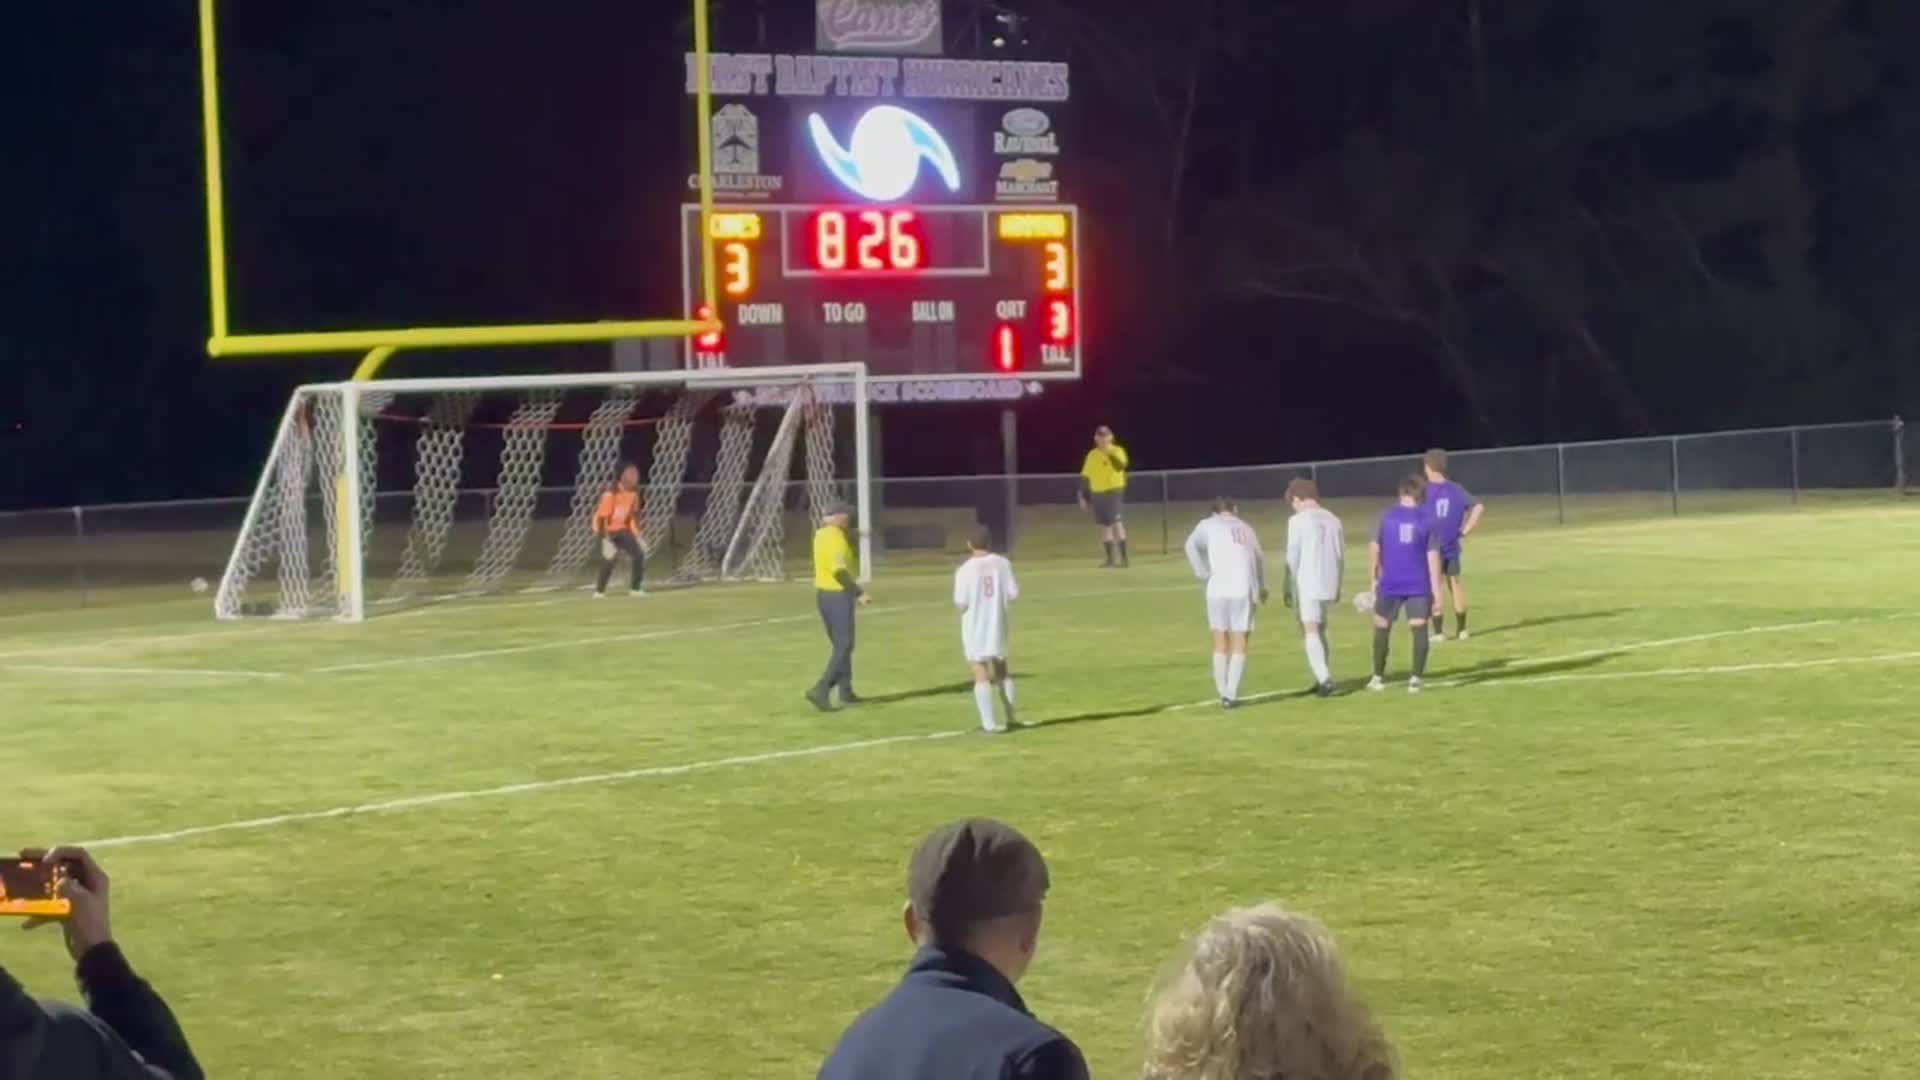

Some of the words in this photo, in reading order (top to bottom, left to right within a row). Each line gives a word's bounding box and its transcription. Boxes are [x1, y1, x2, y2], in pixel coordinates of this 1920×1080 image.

[684, 52, 772, 95] FRST
[775, 54, 898, 97] BAPTIST
[687, 173, 784, 191] CARLESTON
[724, 243, 750, 294] 3
[1045, 242, 1068, 291] 3
[738, 303, 784, 325] DOWN
[822, 302, 842, 323] TO
[844, 302, 866, 324] GO
[1050, 301, 1069, 340] 3
[1000, 326, 1012, 370] 1
[983, 575, 993, 598] 8
